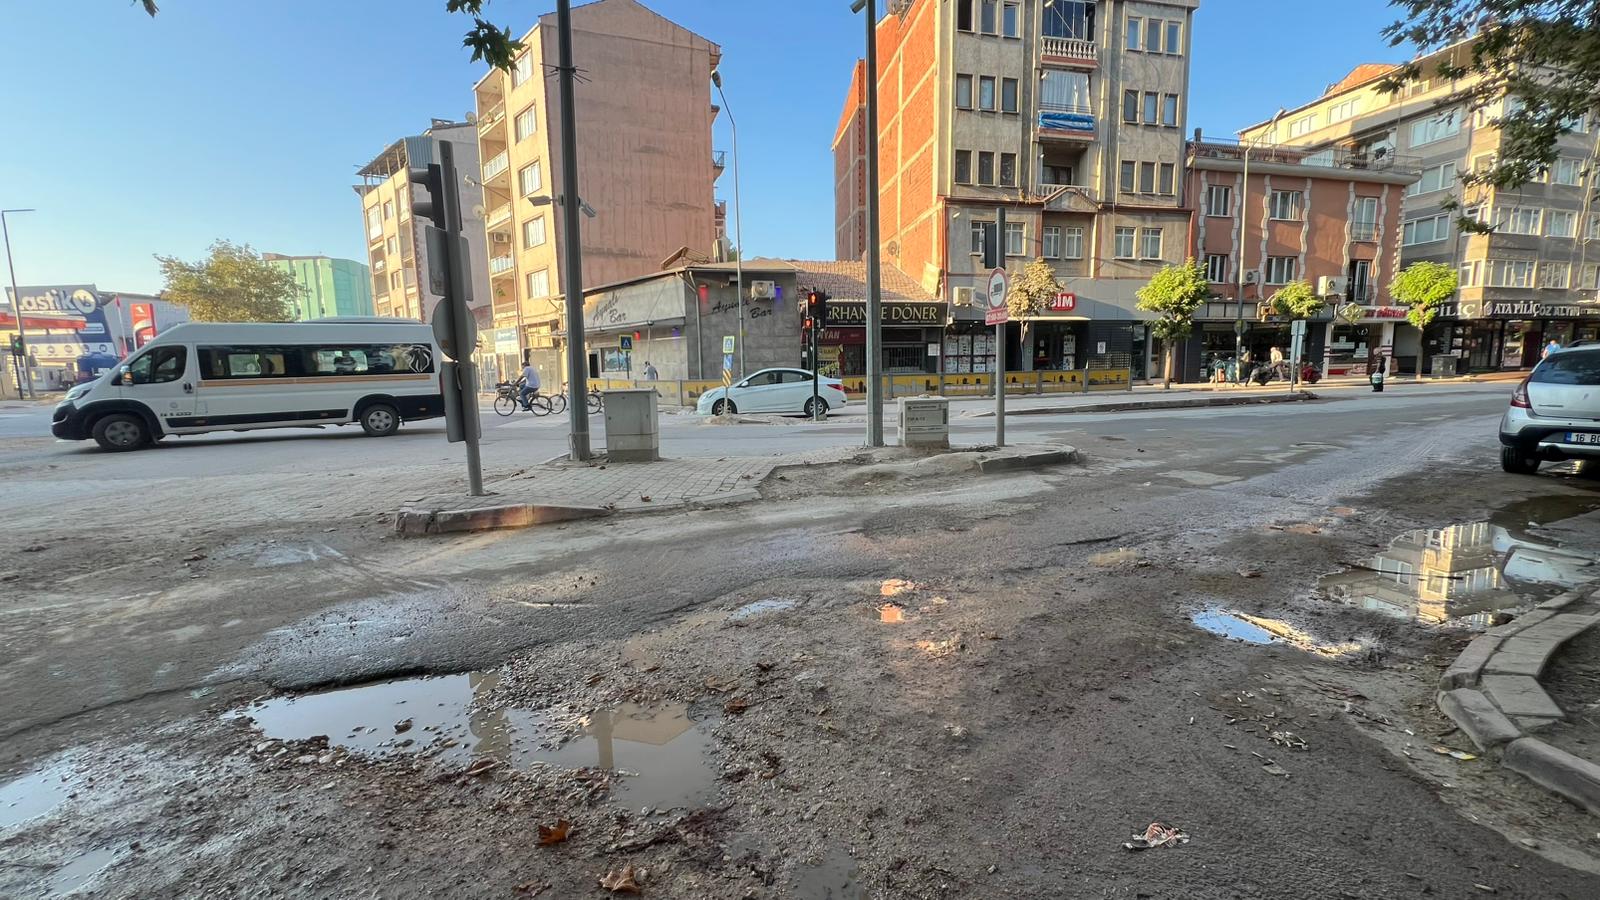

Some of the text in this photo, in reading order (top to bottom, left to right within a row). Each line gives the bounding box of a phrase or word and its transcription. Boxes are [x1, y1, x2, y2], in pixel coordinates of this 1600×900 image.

[750, 307, 772, 319] Bar
[891, 303, 937, 320] DÖNER
[1494, 303, 1512, 314] ATA
[1575, 433, 1586, 442] 16
